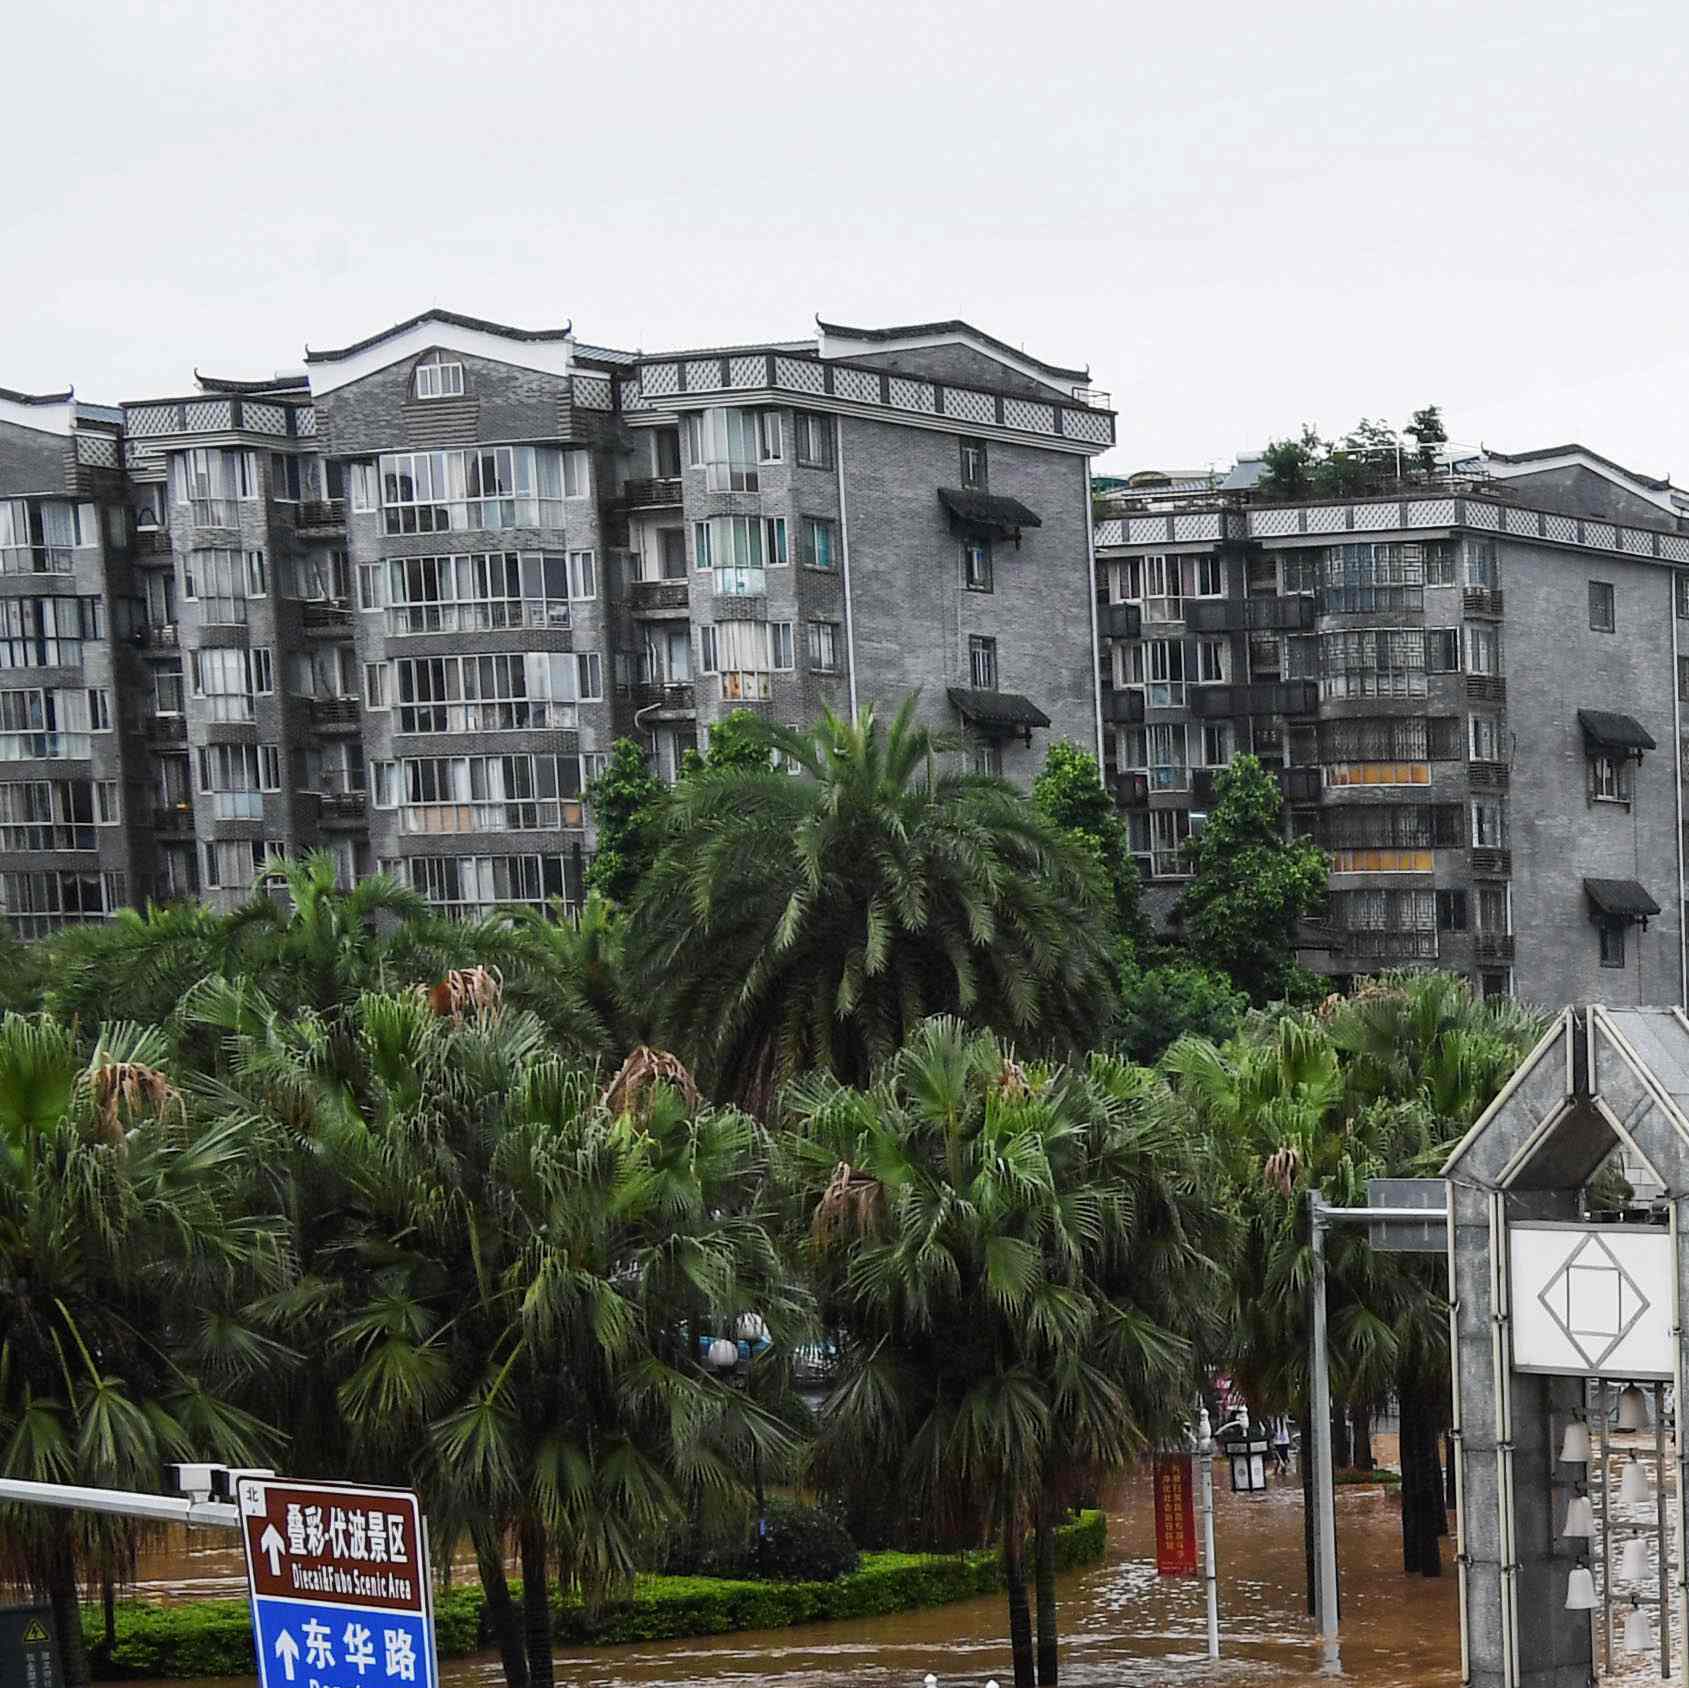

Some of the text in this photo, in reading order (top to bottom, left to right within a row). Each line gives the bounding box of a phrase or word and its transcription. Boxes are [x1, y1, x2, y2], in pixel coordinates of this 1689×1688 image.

[246, 1487, 259, 1503] 北
[353, 1569, 387, 1598] Scenic
[388, 1572, 411, 1600] Area
[301, 1617, 416, 1681] 东华路
